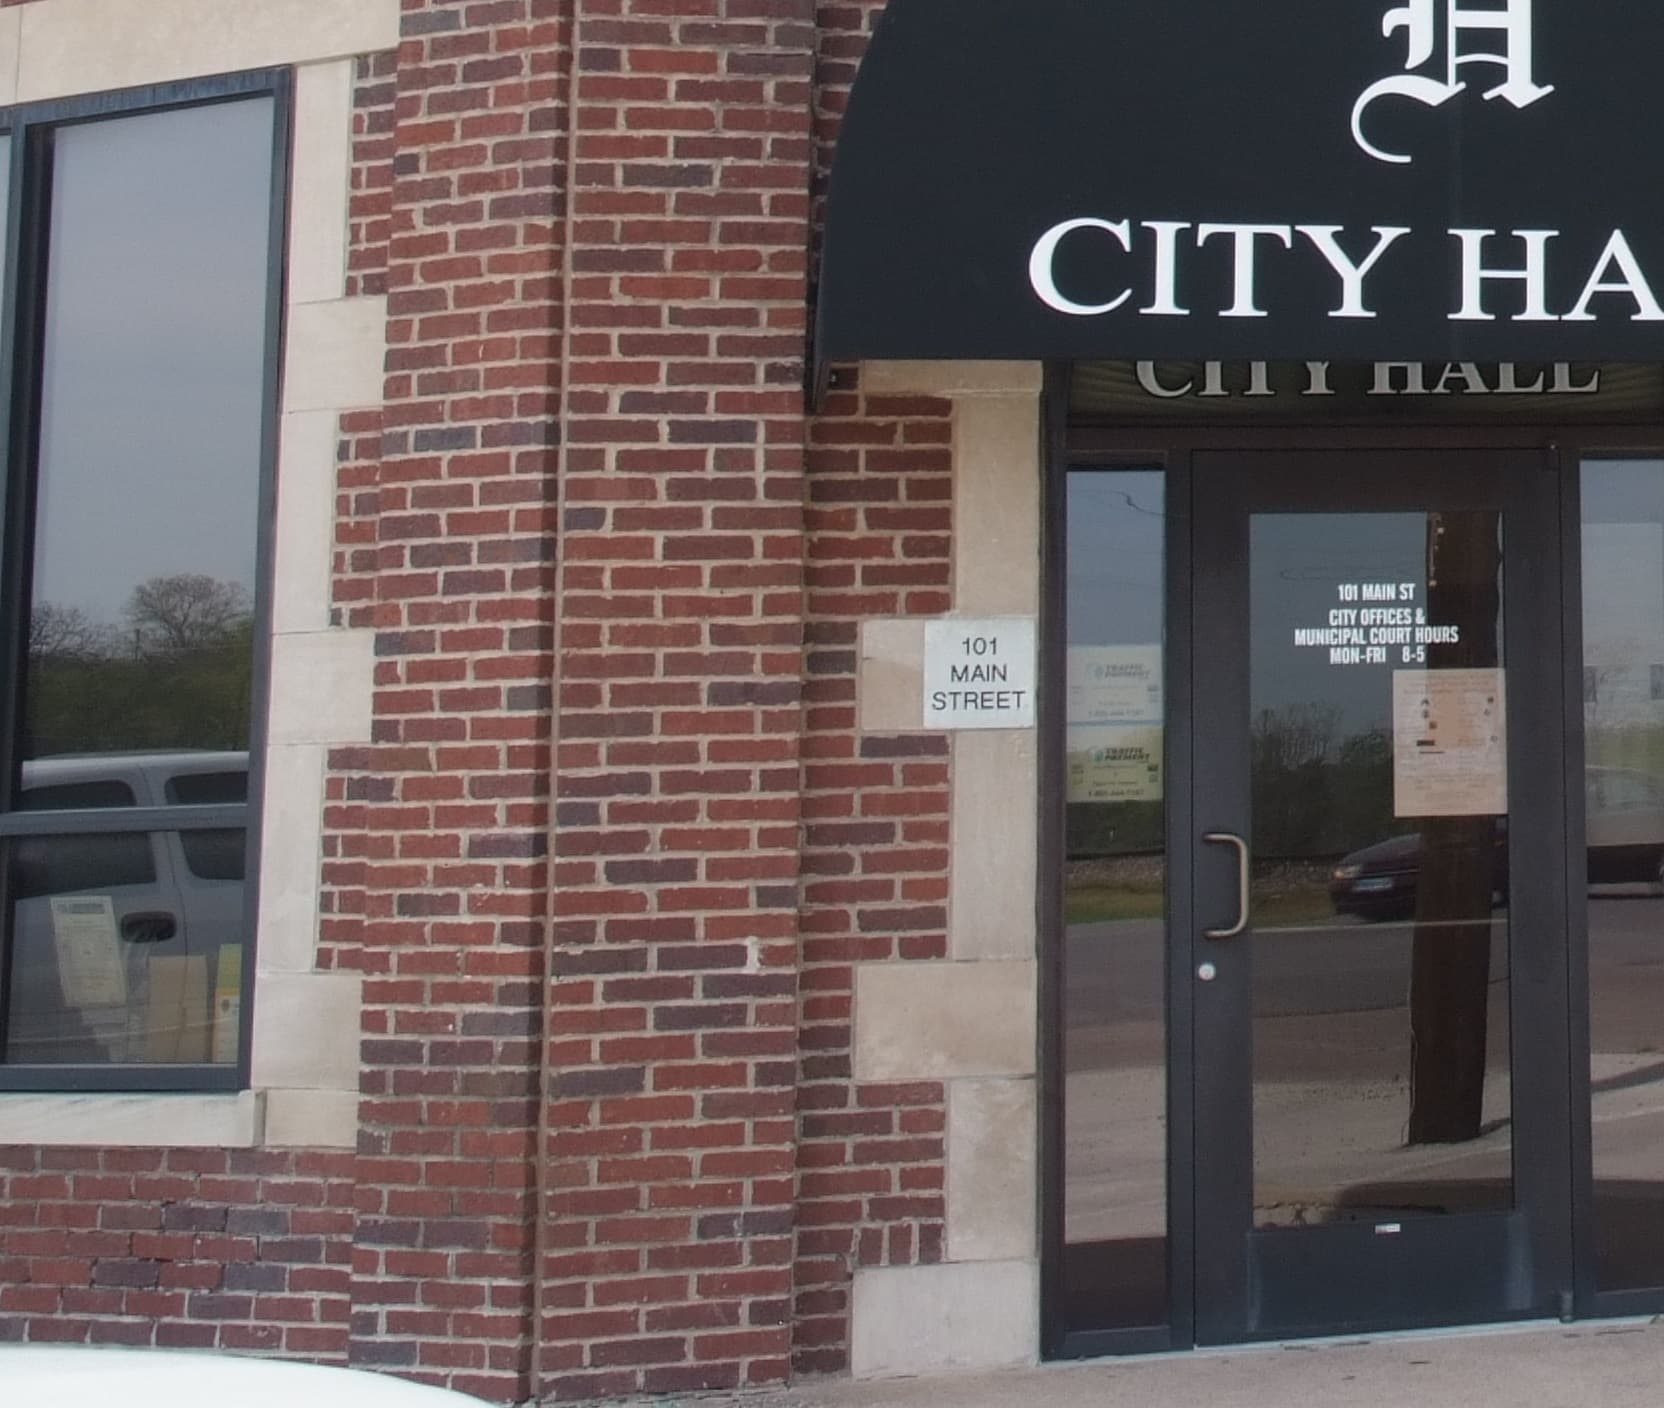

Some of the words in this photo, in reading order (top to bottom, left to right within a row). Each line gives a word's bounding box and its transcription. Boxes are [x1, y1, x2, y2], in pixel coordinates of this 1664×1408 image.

[1028, 217, 1411, 318] CITY
[1337, 583, 1359, 601] 101
[1362, 583, 1396, 601] MAIN
[1399, 582, 1416, 601] ST
[1328, 608, 1358, 626] CITY
[1360, 607, 1412, 626] OFFICES
[1415, 607, 1426, 625] &
[1294, 627, 1367, 646] MUNICIPAL
[1369, 627, 1412, 645] COURT
[1414, 626, 1459, 644] HOURS
[962, 637, 997, 656] 101
[1329, 646, 1387, 665] MON-FRI
[1402, 645, 1426, 663] 8-5
[950, 663, 1008, 683] MAIN
[932, 690, 1027, 711] STREET
